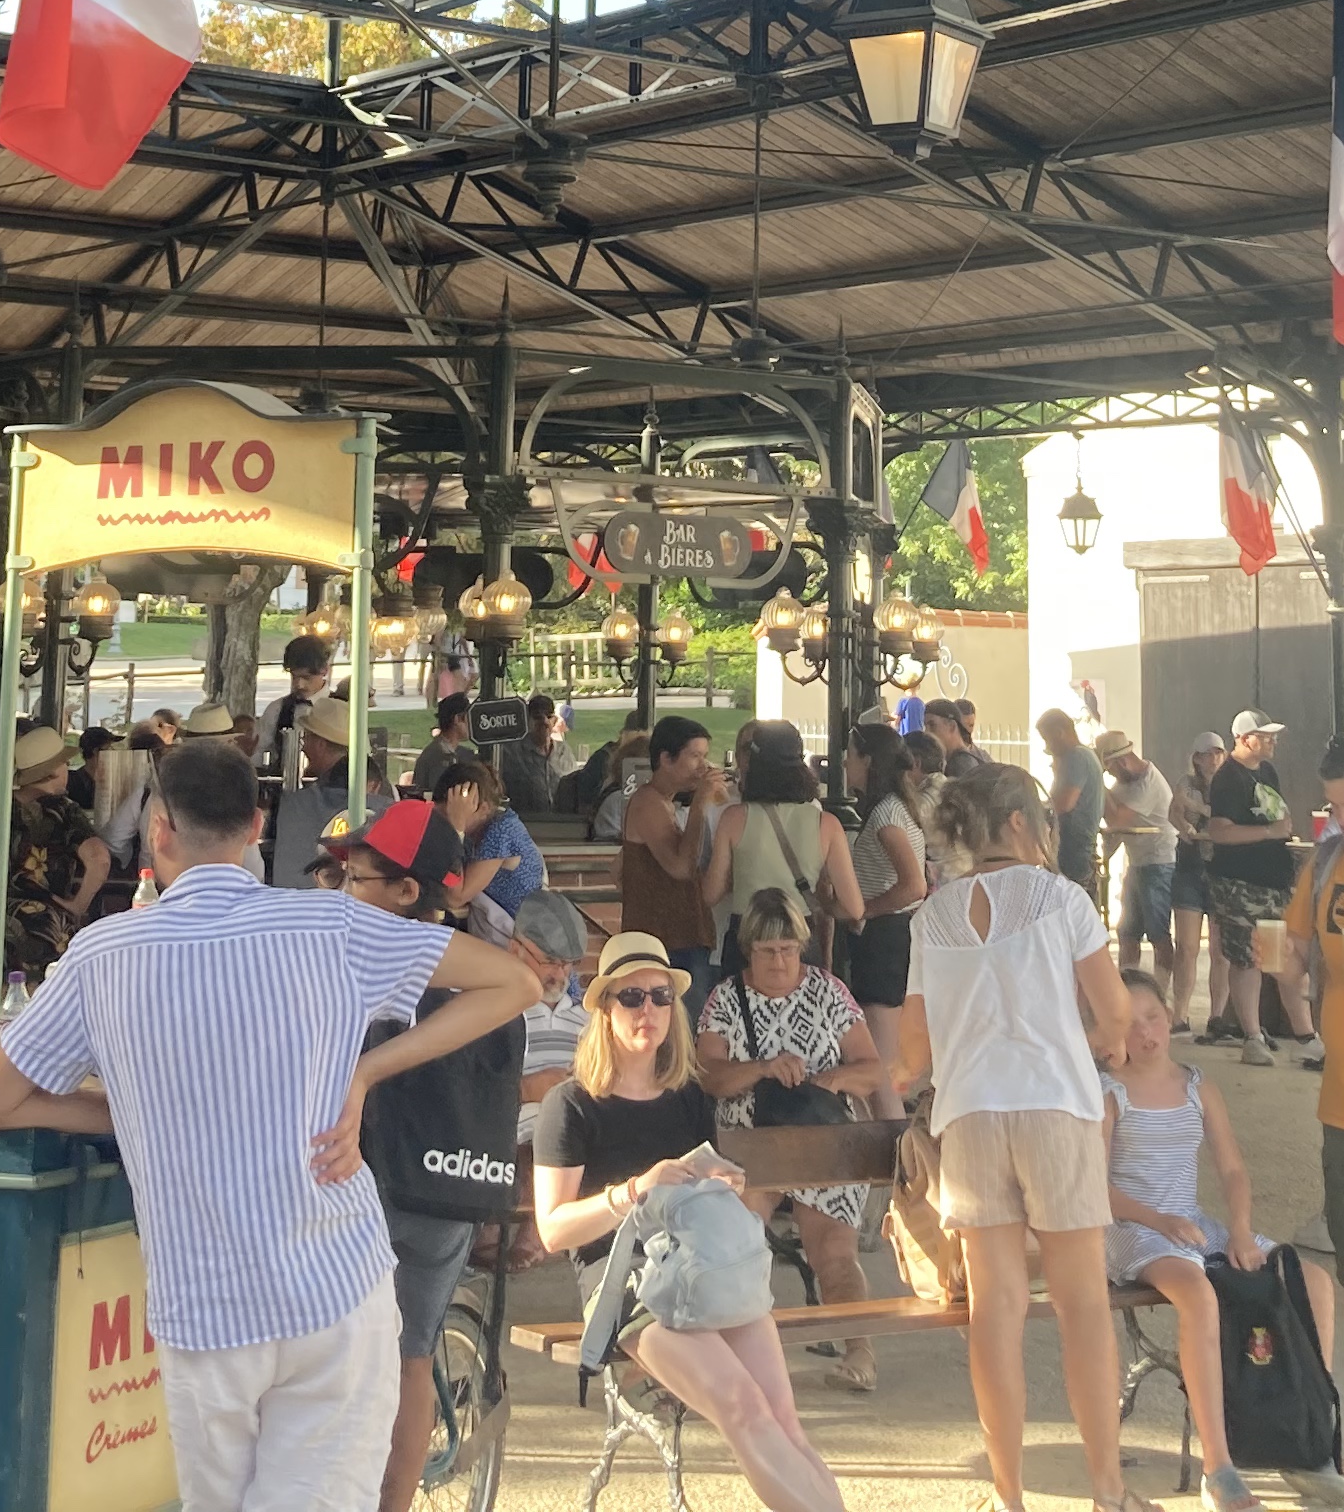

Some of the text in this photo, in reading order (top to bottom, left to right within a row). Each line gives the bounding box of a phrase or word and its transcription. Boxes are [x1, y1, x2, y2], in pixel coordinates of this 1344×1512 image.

[97, 440, 275, 499] MIKO
[663, 520, 696, 545] BAR
[658, 544, 714, 568] BIÈRES
[479, 714, 518, 731] SORTIE
[422, 1148, 516, 1186] adidas
